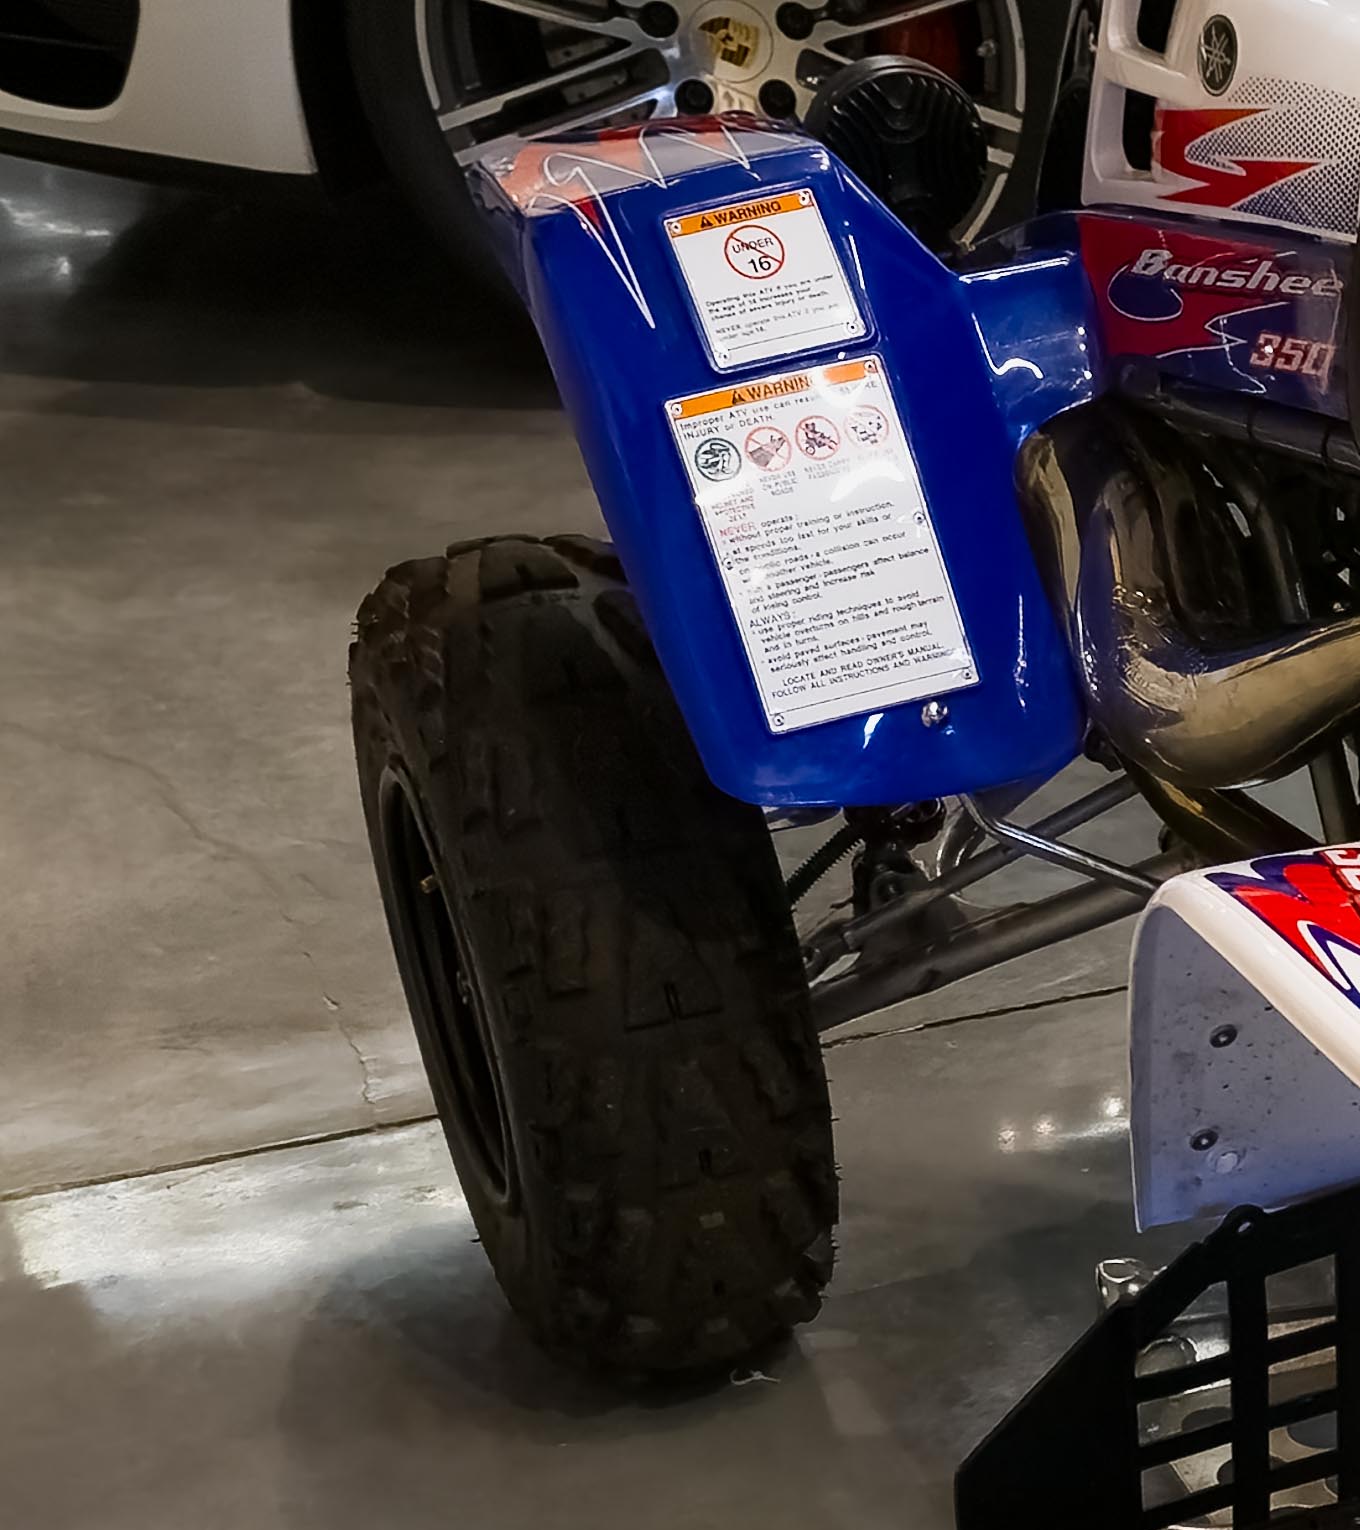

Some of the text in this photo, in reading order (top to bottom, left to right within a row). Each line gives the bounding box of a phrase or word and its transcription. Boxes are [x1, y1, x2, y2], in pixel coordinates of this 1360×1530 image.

[713, 200, 782, 224] WARNING
[732, 237, 774, 253] UNDER
[748, 255, 772, 273] 16
[1130, 248, 1344, 297] Banshee
[1250, 330, 1338, 378] 350
[745, 376, 810, 400] WARNIN
